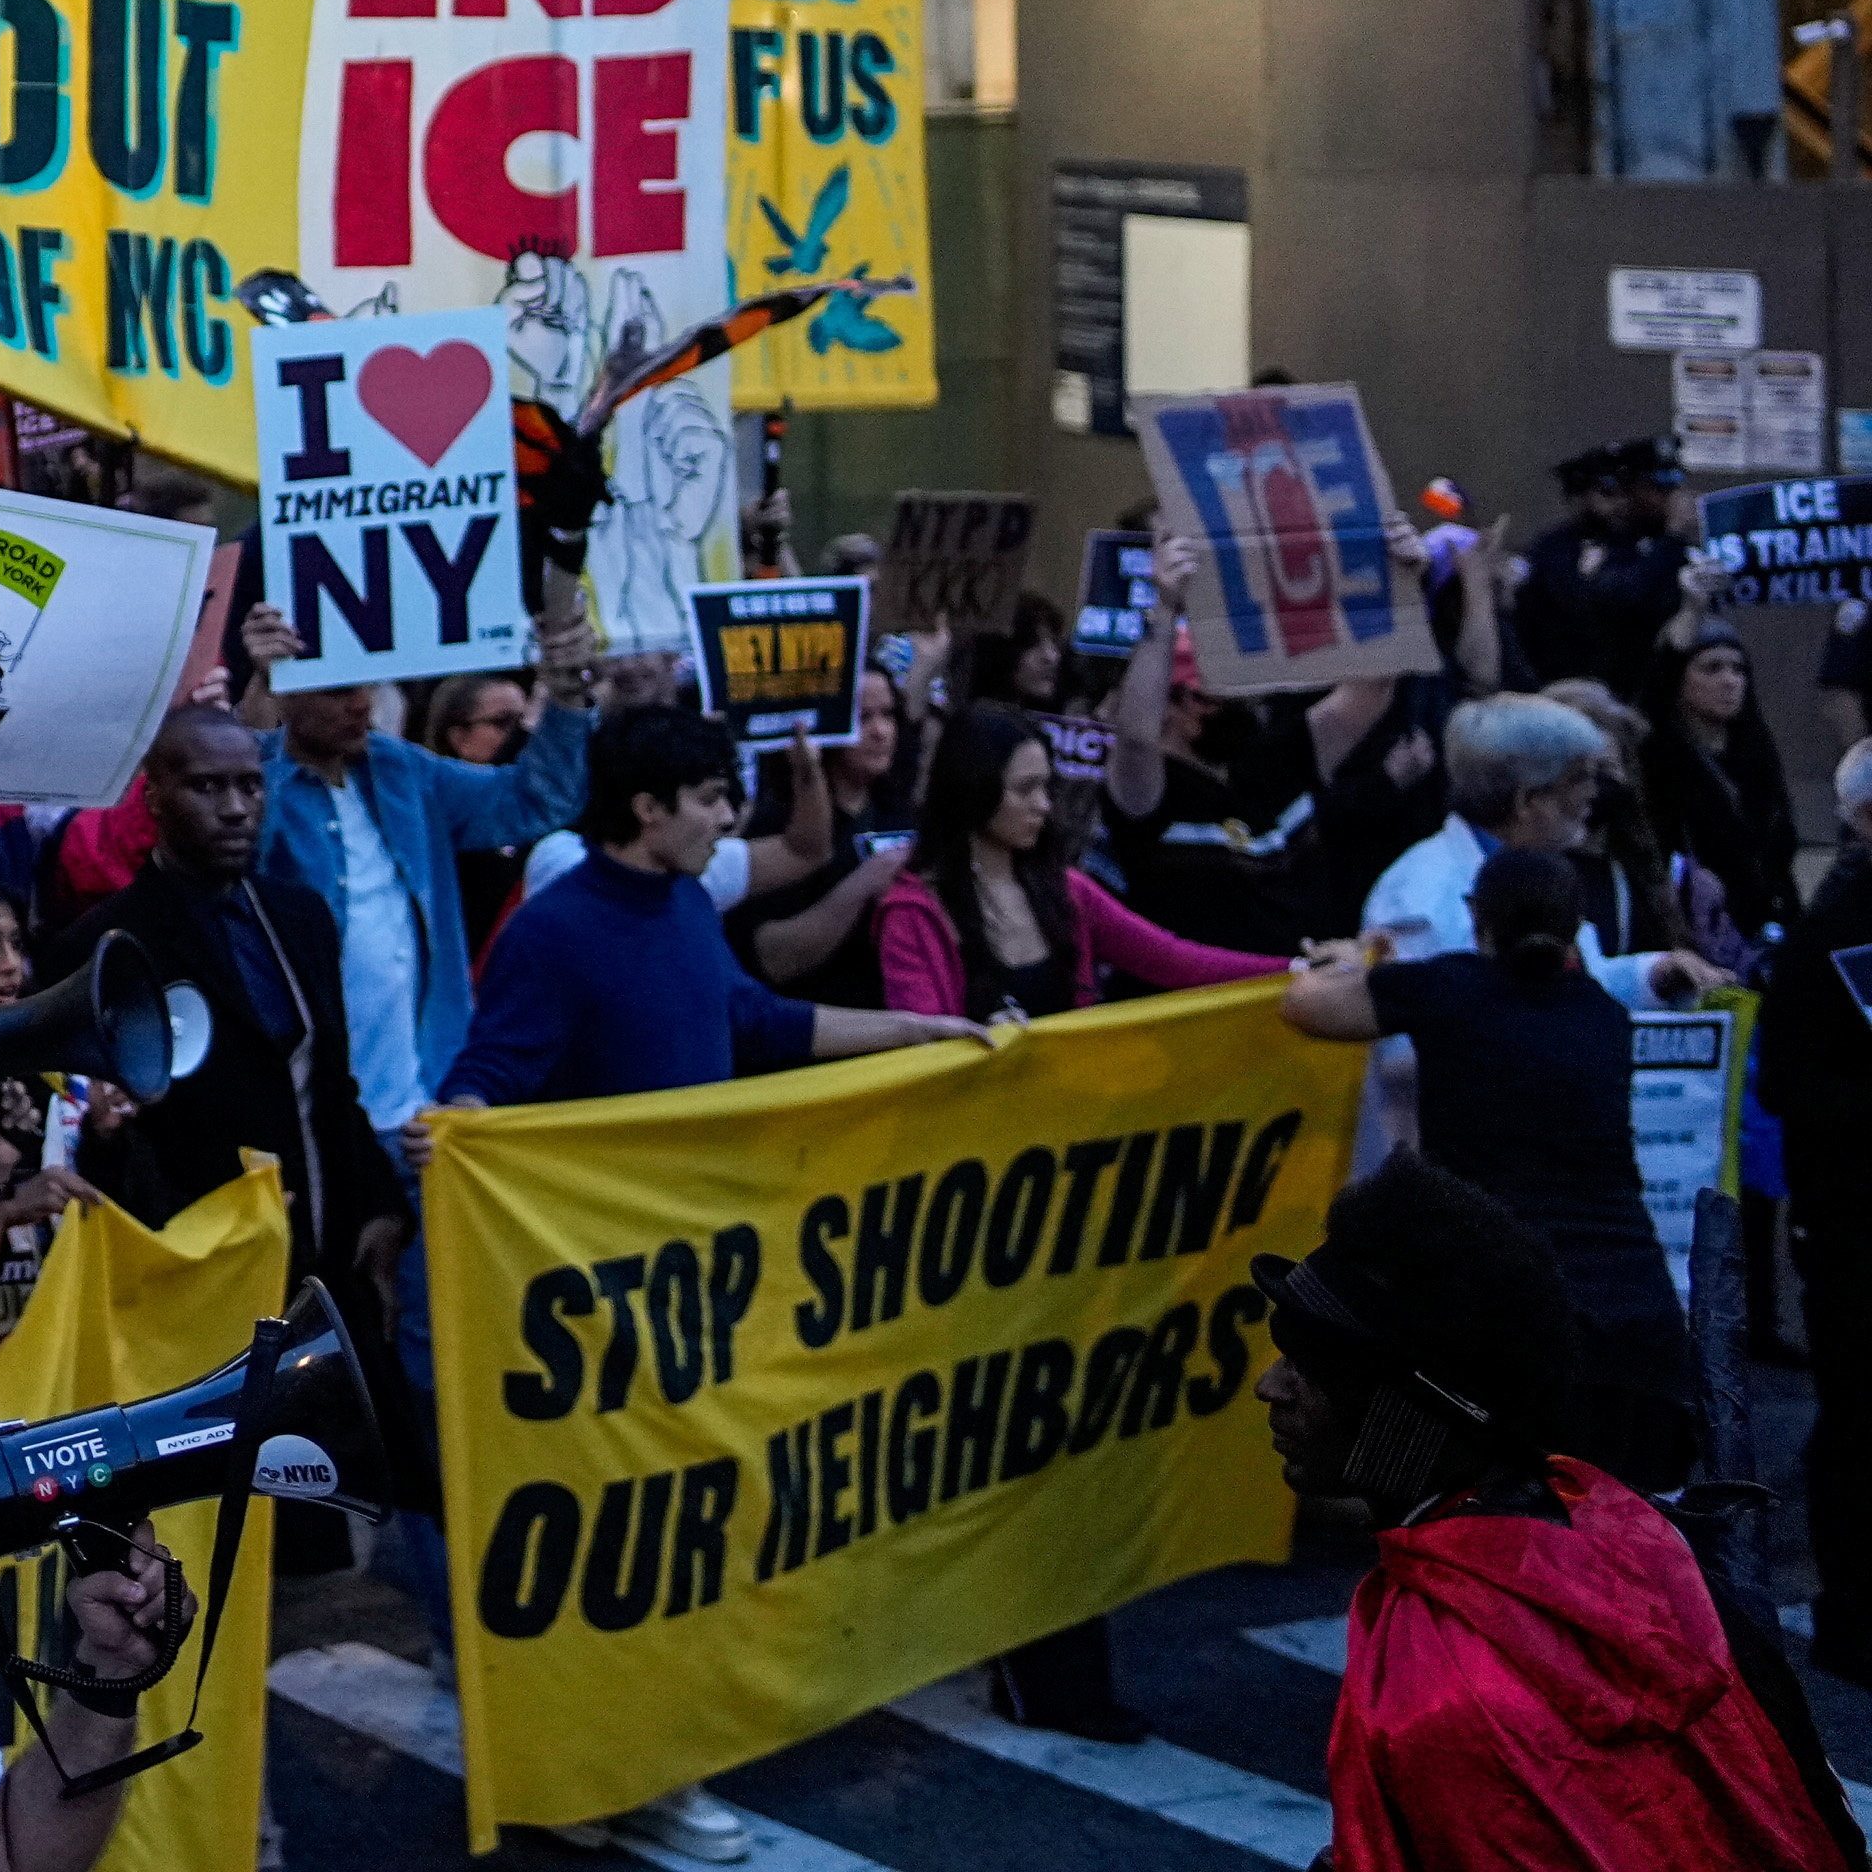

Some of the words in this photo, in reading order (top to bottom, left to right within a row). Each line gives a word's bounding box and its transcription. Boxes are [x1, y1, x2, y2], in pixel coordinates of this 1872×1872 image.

[798, 28, 900, 145] US
[332, 48, 694, 269] ICE
[104, 225, 236, 388] NYC
[277, 352, 352, 482] I
[272, 470, 506, 526] IMMIGRANT
[1774, 480, 1841, 523] ICE
[2, 563, 46, 596] YORK
[289, 513, 501, 661] NY
[1769, 567, 1852, 604] KILL
[501, 1220, 762, 1423] STOP
[25, 1455, 35, 1475] I
[38, 1437, 108, 1471] VOTE
[167, 1435, 201, 1450] NYIC
[282, 1463, 331, 1484] NYIC
[476, 1455, 741, 1641] OUR
[753, 1281, 1273, 1586] NEIGHBORS
